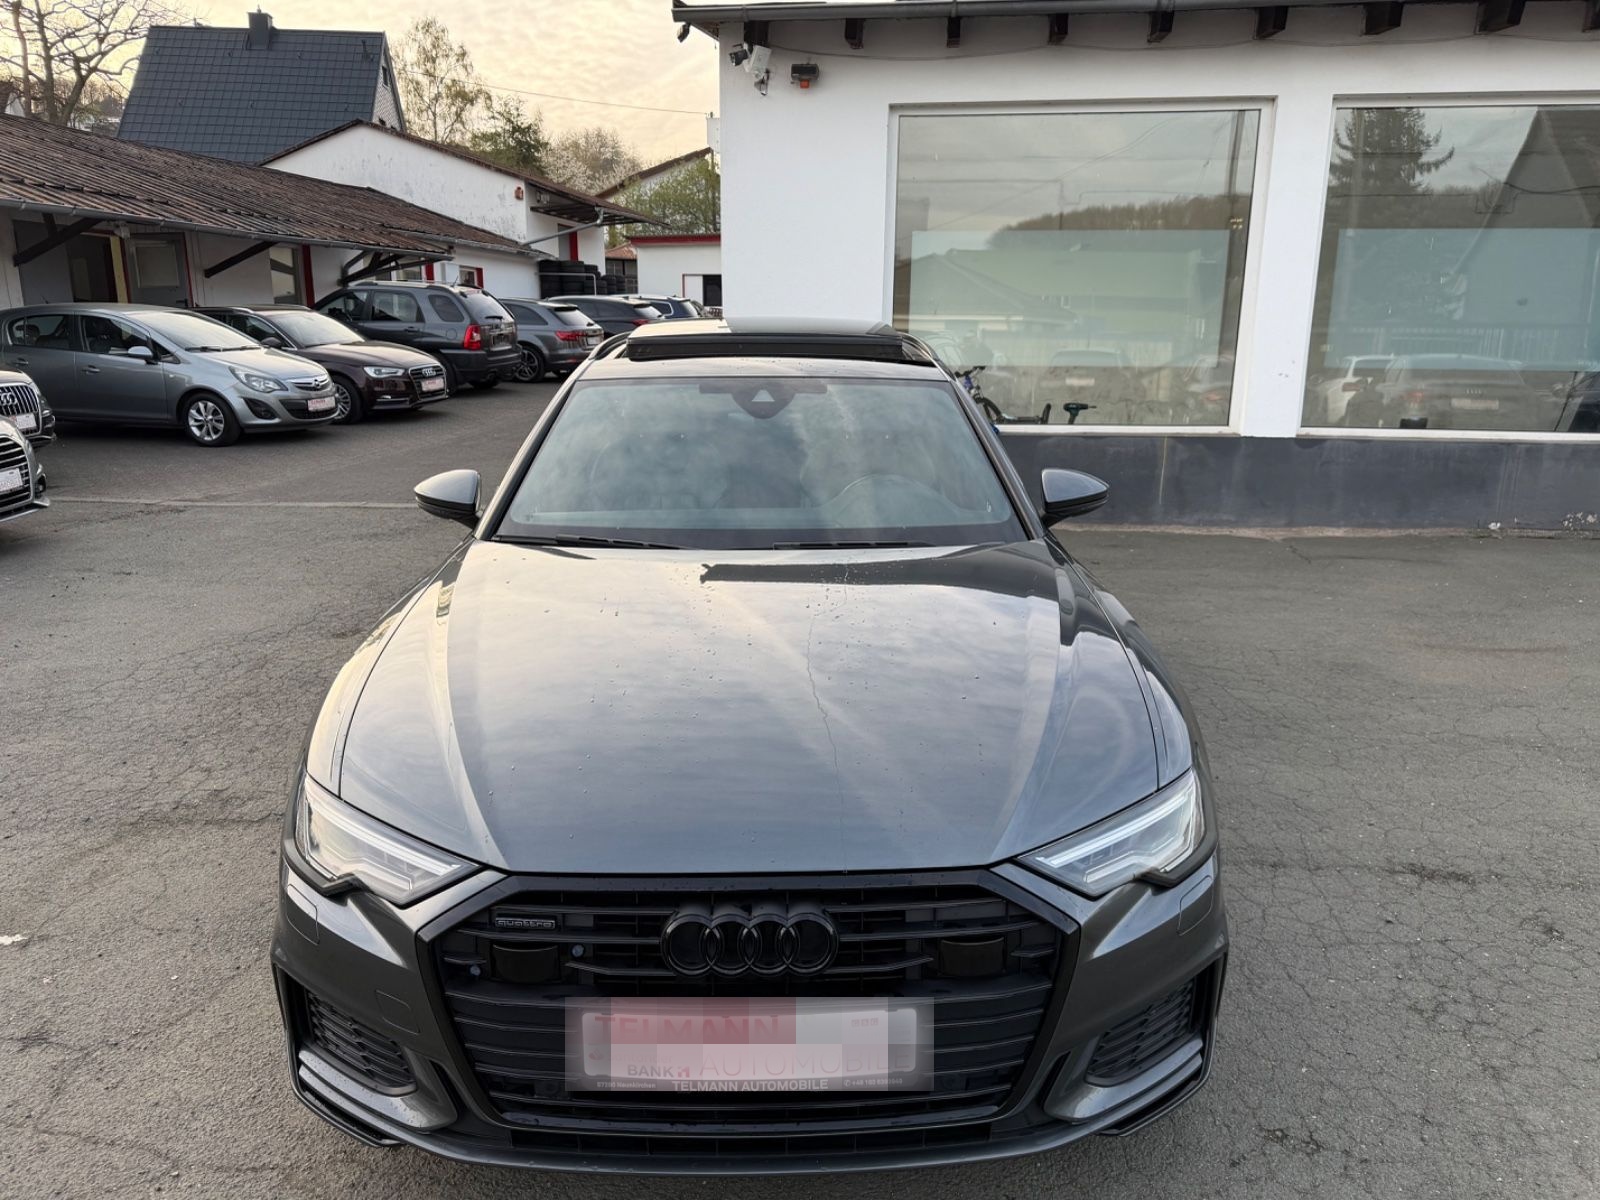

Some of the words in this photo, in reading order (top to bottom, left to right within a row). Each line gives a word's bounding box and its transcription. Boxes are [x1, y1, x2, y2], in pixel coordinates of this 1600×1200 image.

[607, 1052, 673, 1064] antander
[698, 1047, 911, 1077] AUTOMOBILE
[627, 1065, 674, 1078] BANK
[671, 1081, 738, 1092] TELMANN
[741, 1079, 829, 1092] AUTOMOBILE
